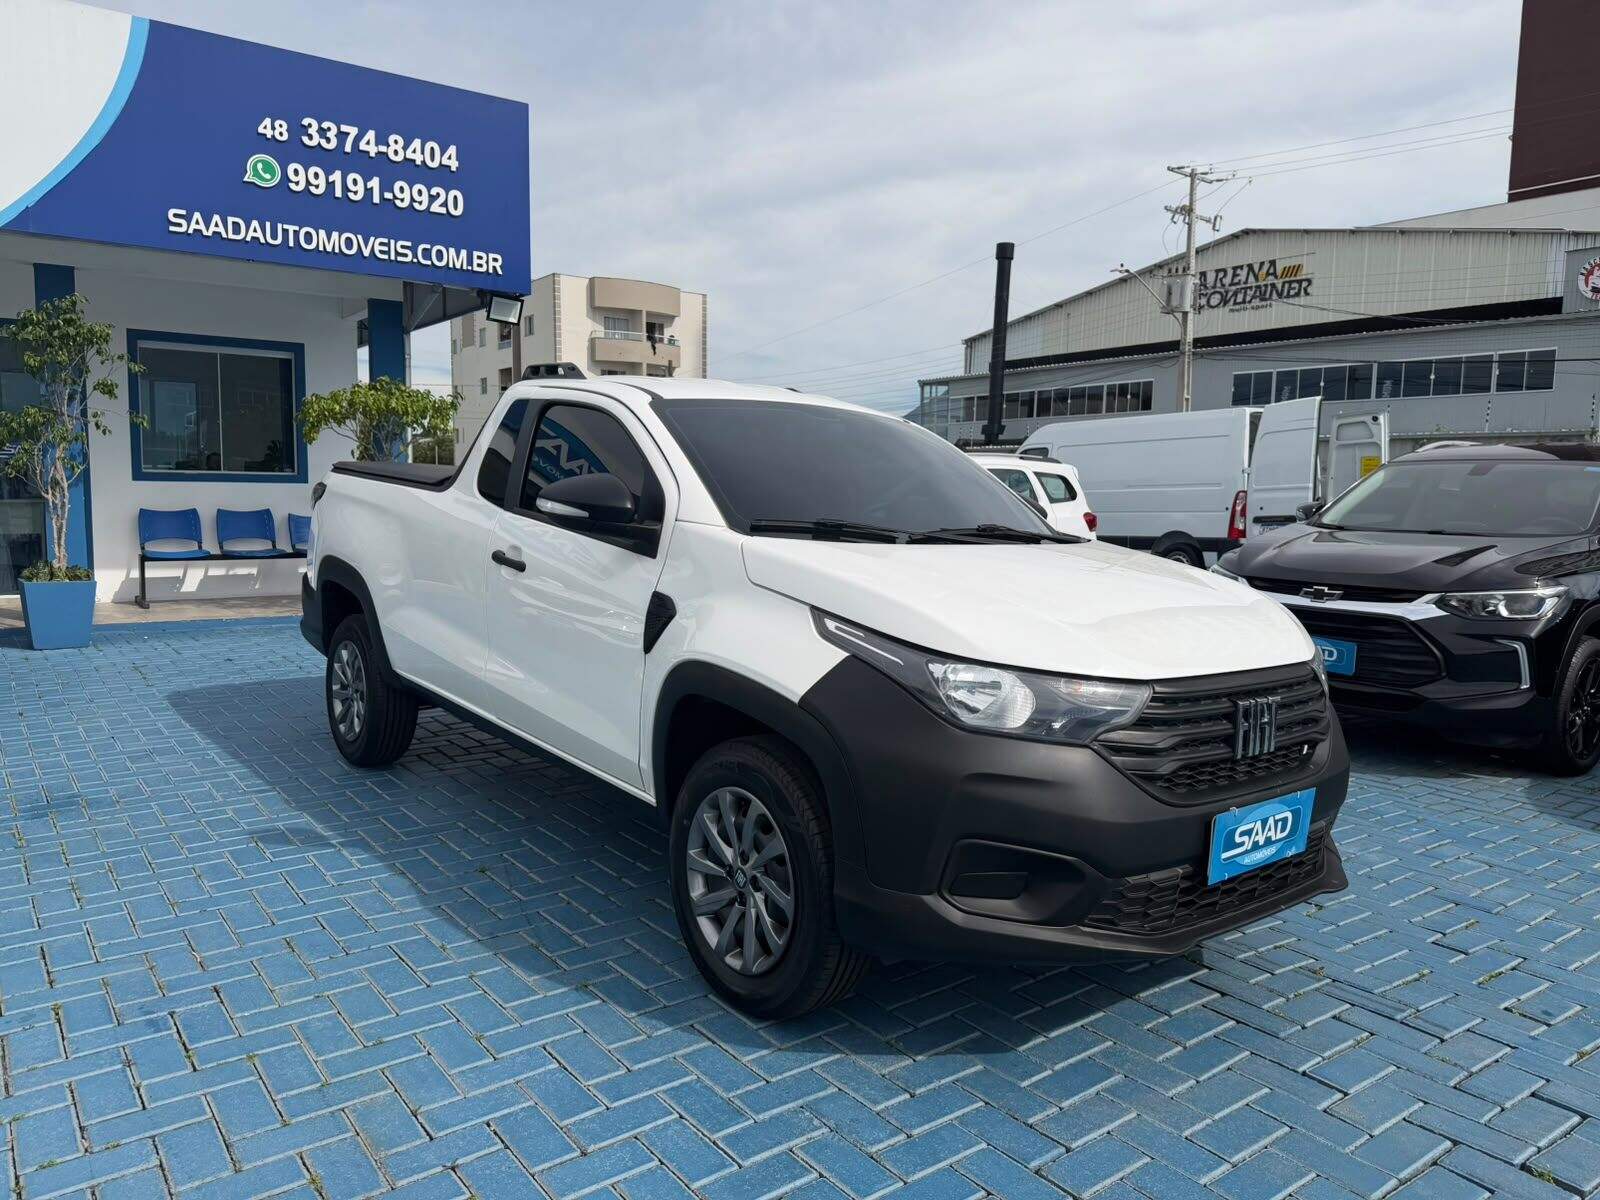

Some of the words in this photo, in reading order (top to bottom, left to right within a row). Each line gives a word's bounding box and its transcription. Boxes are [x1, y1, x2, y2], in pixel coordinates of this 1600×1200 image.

[257, 117, 289, 142] 48
[301, 117, 460, 172] 3374-8404
[286, 163, 464, 217] 99191-9920
[167, 207, 503, 275] SAADAUTOMOVEIS.COM.BR
[1221, 811, 1293, 859] SAAD
